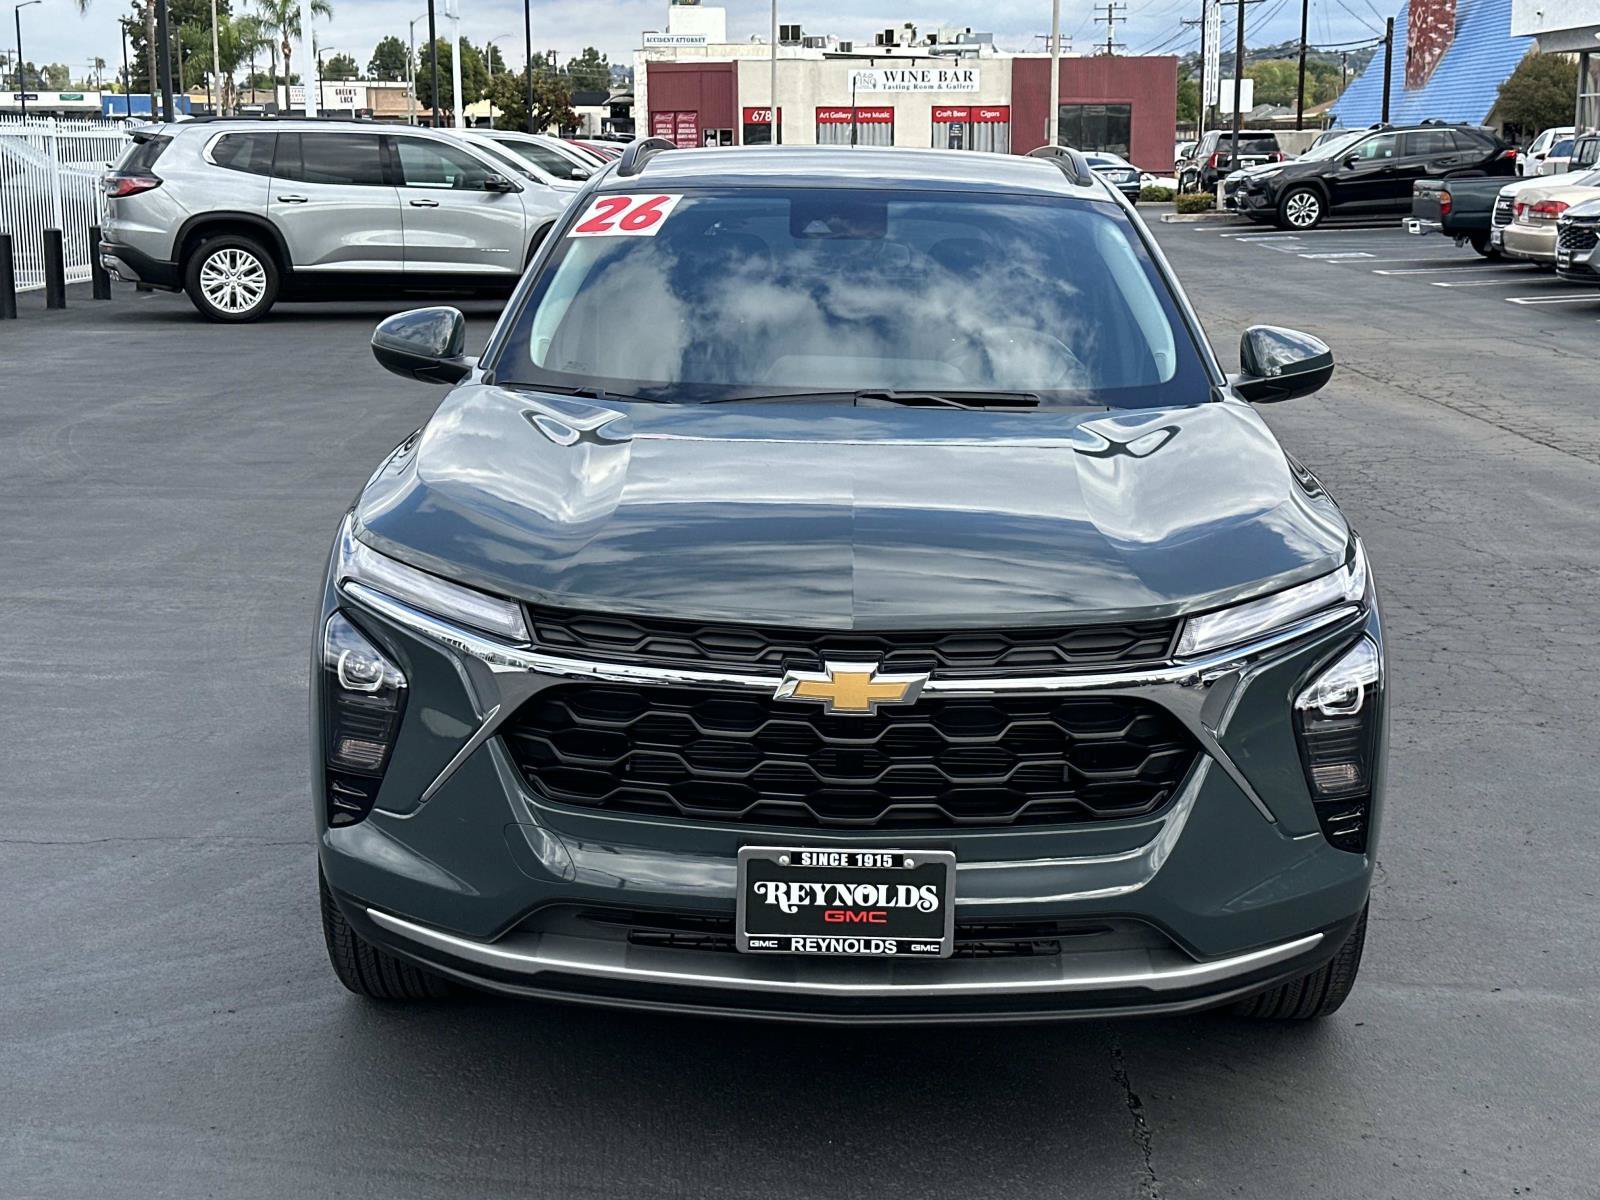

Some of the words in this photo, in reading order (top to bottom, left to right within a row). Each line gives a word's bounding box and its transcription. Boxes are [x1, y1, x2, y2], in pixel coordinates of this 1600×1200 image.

[883, 70, 931, 83] WINE
[938, 70, 974, 83] BAR
[335, 88, 357, 96] GREEN'S
[882, 83, 911, 91] Tasting
[946, 83, 974, 91] Gallery
[751, 110, 772, 122] 678
[830, 111, 852, 119] Gallery
[980, 110, 1000, 118] Cigars
[575, 196, 671, 233] 26
[801, 852, 849, 867] SINCE
[855, 853, 893, 868] 1915
[753, 881, 939, 914] REYNOLDS
[824, 910, 888, 923] GMC
[749, 940, 779, 948] GMC
[791, 938, 897, 954] REYNOLDS
[911, 944, 940, 952] GMC
